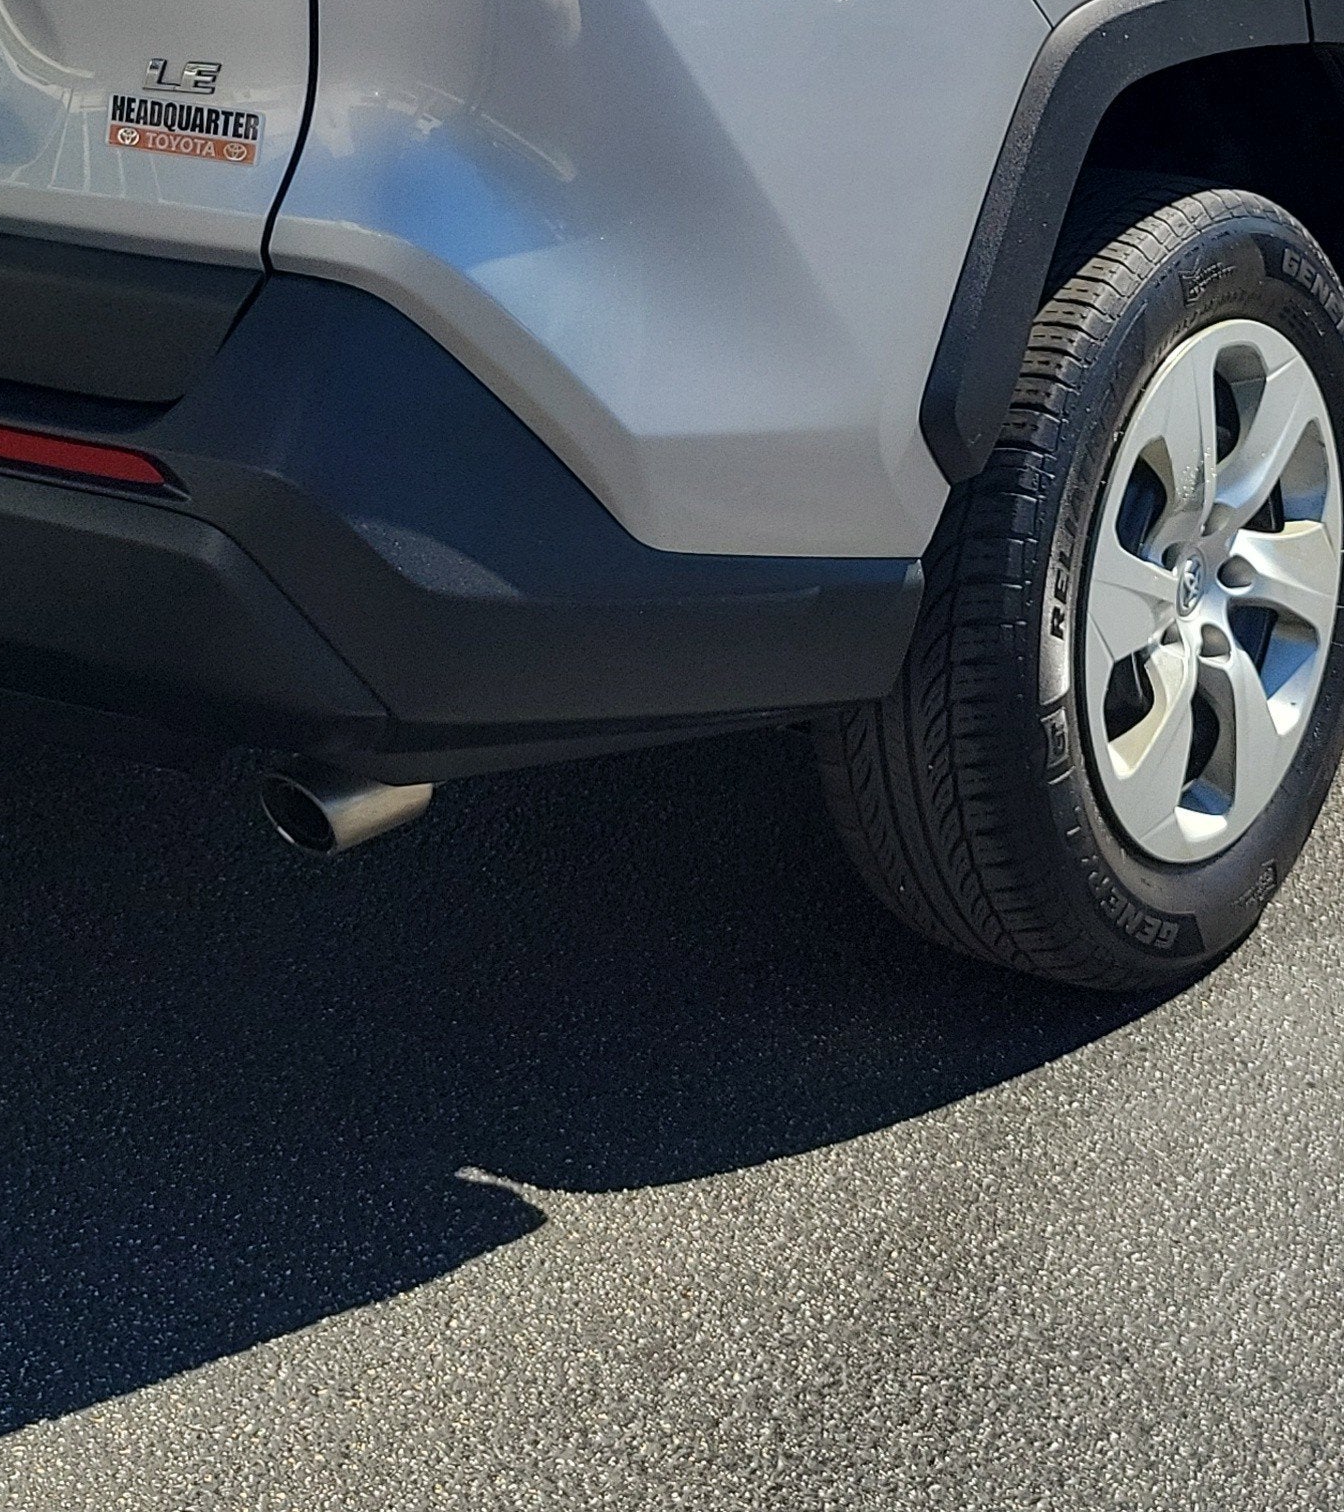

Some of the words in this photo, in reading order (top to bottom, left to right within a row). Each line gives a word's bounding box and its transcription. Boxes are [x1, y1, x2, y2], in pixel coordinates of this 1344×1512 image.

[142, 58, 223, 95] LE
[111, 94, 260, 141] HEADQUARTER
[145, 132, 216, 158] TOYOTA
